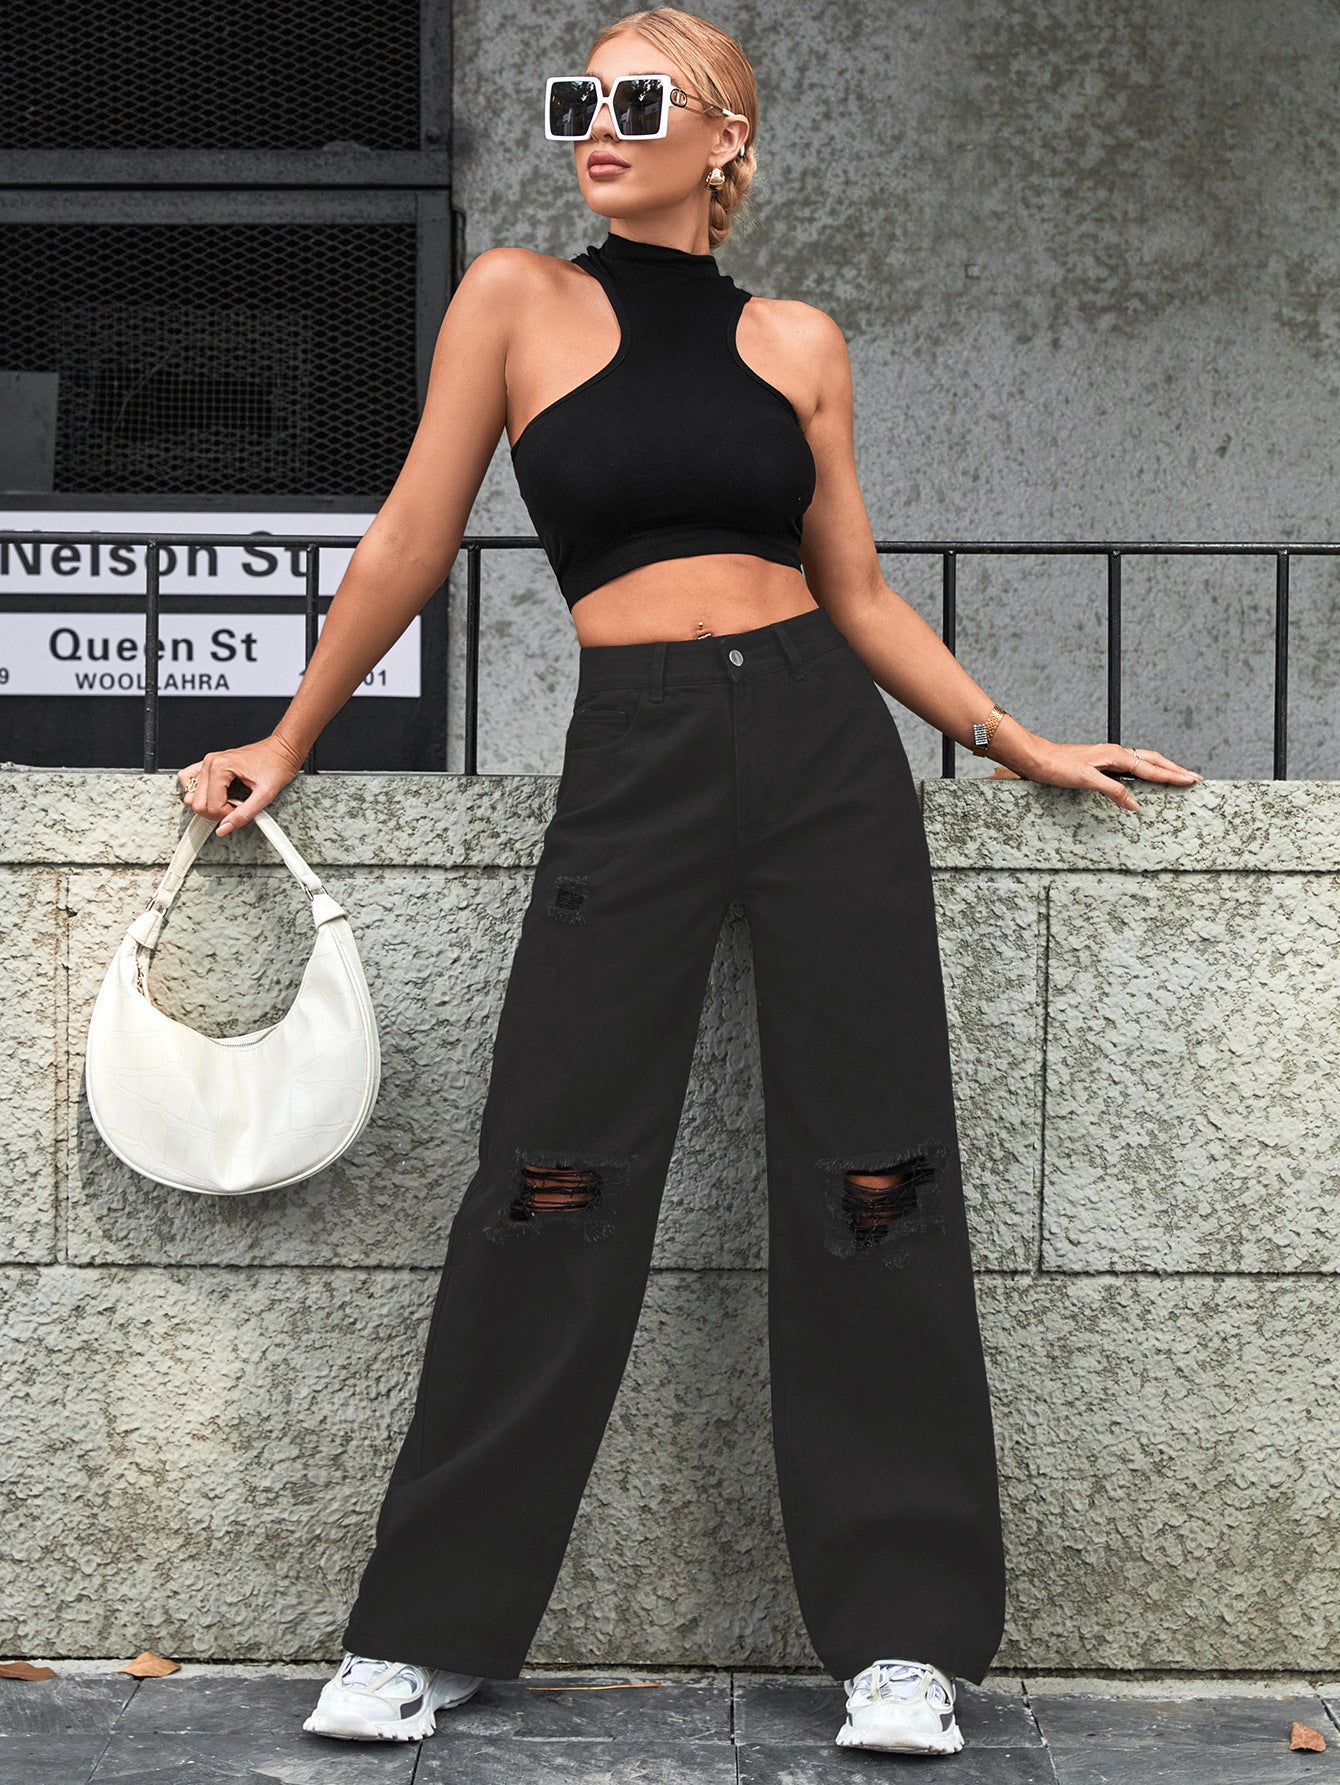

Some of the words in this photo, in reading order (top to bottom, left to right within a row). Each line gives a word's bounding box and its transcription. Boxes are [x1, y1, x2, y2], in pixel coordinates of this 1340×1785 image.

[0, 531, 218, 577] Nelson
[242, 531, 308, 577] St
[210, 628, 258, 662] St
[75, 672, 230, 690] WOOLAHRA
